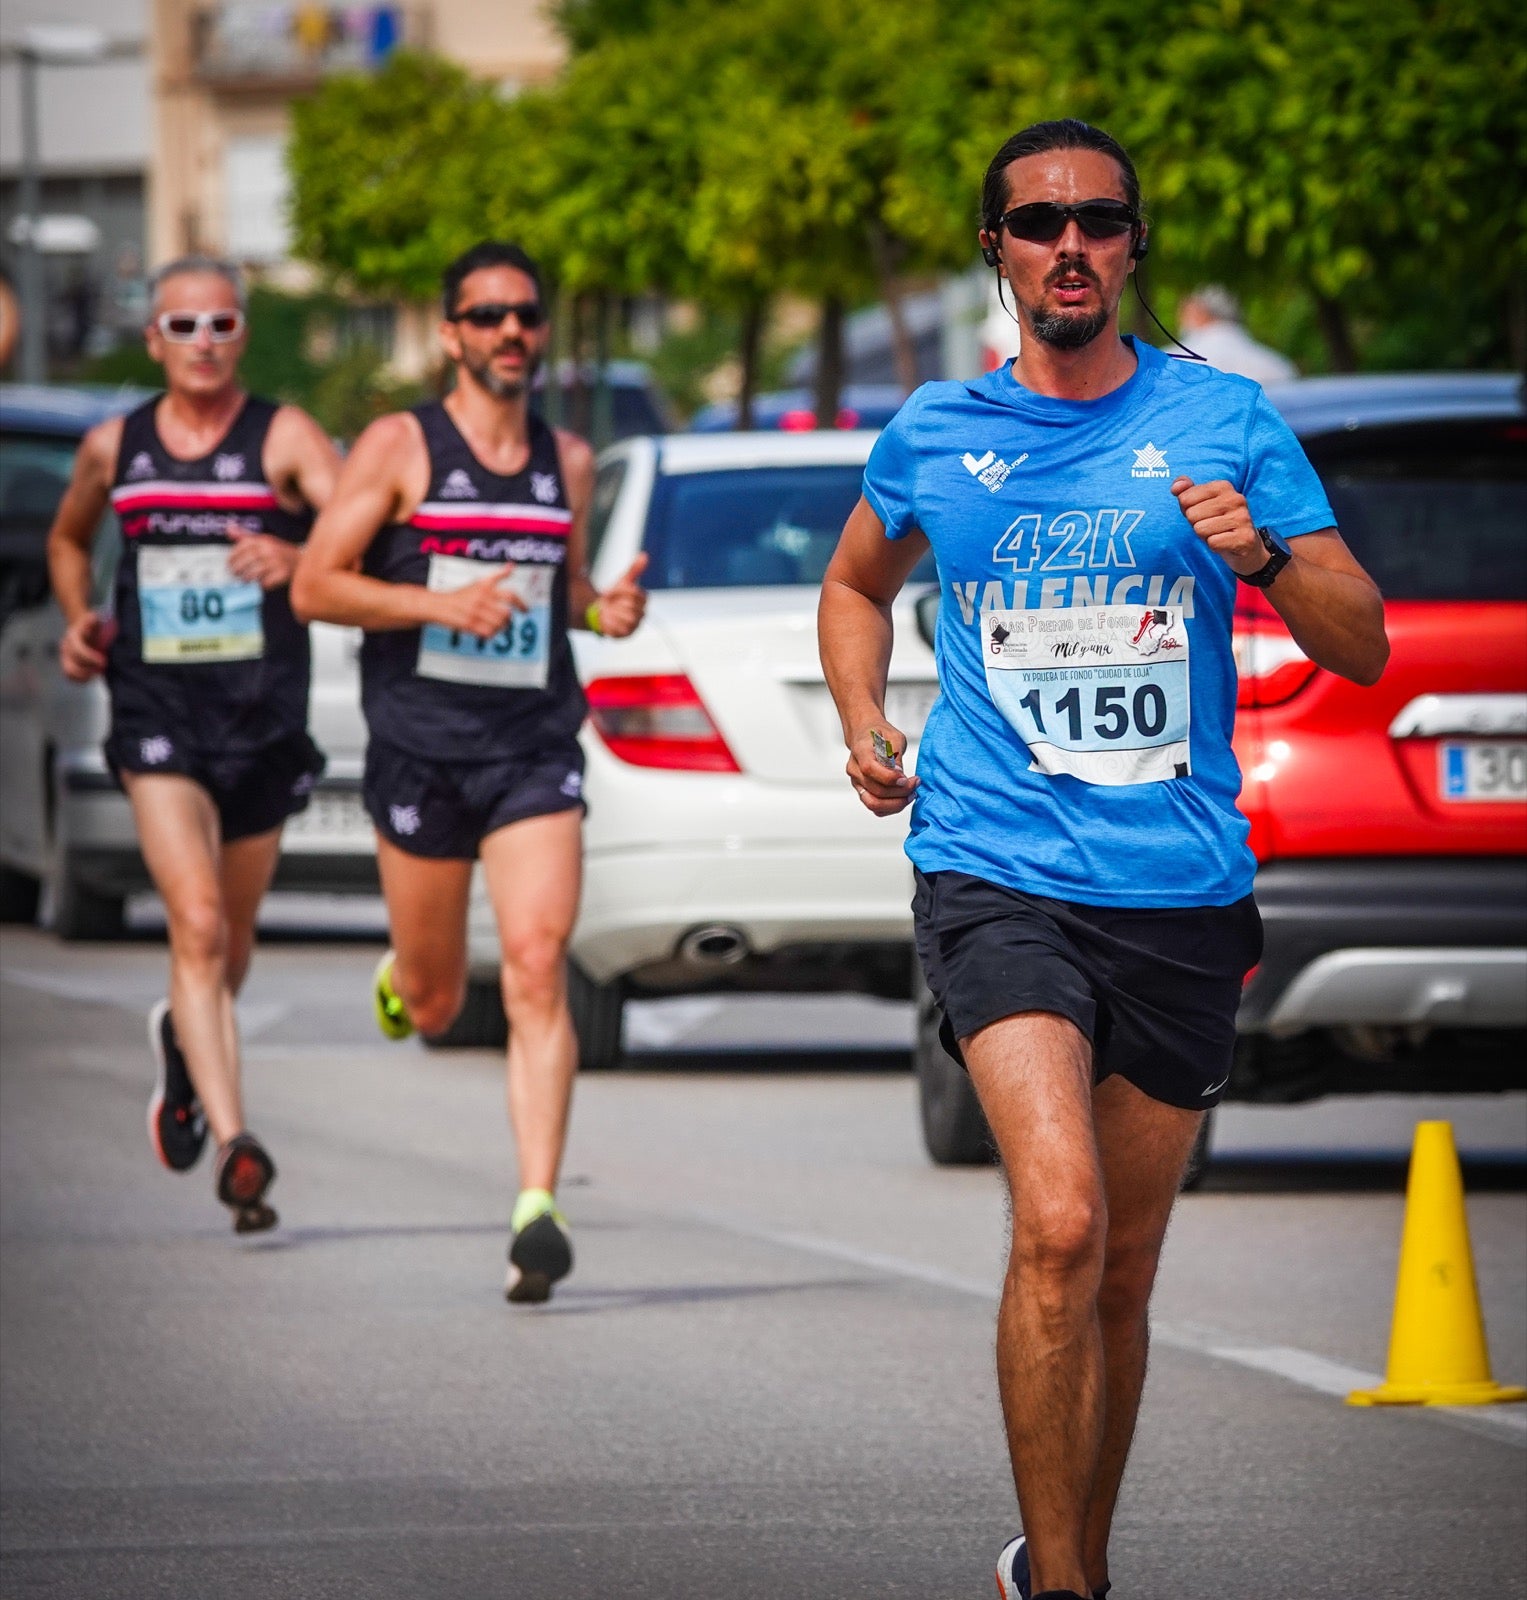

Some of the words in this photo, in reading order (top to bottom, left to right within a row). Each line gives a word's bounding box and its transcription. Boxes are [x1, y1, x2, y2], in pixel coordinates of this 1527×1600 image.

[1131, 468, 1170, 478] luanvi
[993, 508, 1146, 573] 42K
[952, 574, 1197, 626] VALENCIA
[1032, 671, 1058, 682] PRUEBA
[1060, 670, 1069, 681] DE
[1070, 669, 1093, 680] FONDO
[1124, 668, 1132, 678] DE
[1019, 684, 1167, 741] 1150
